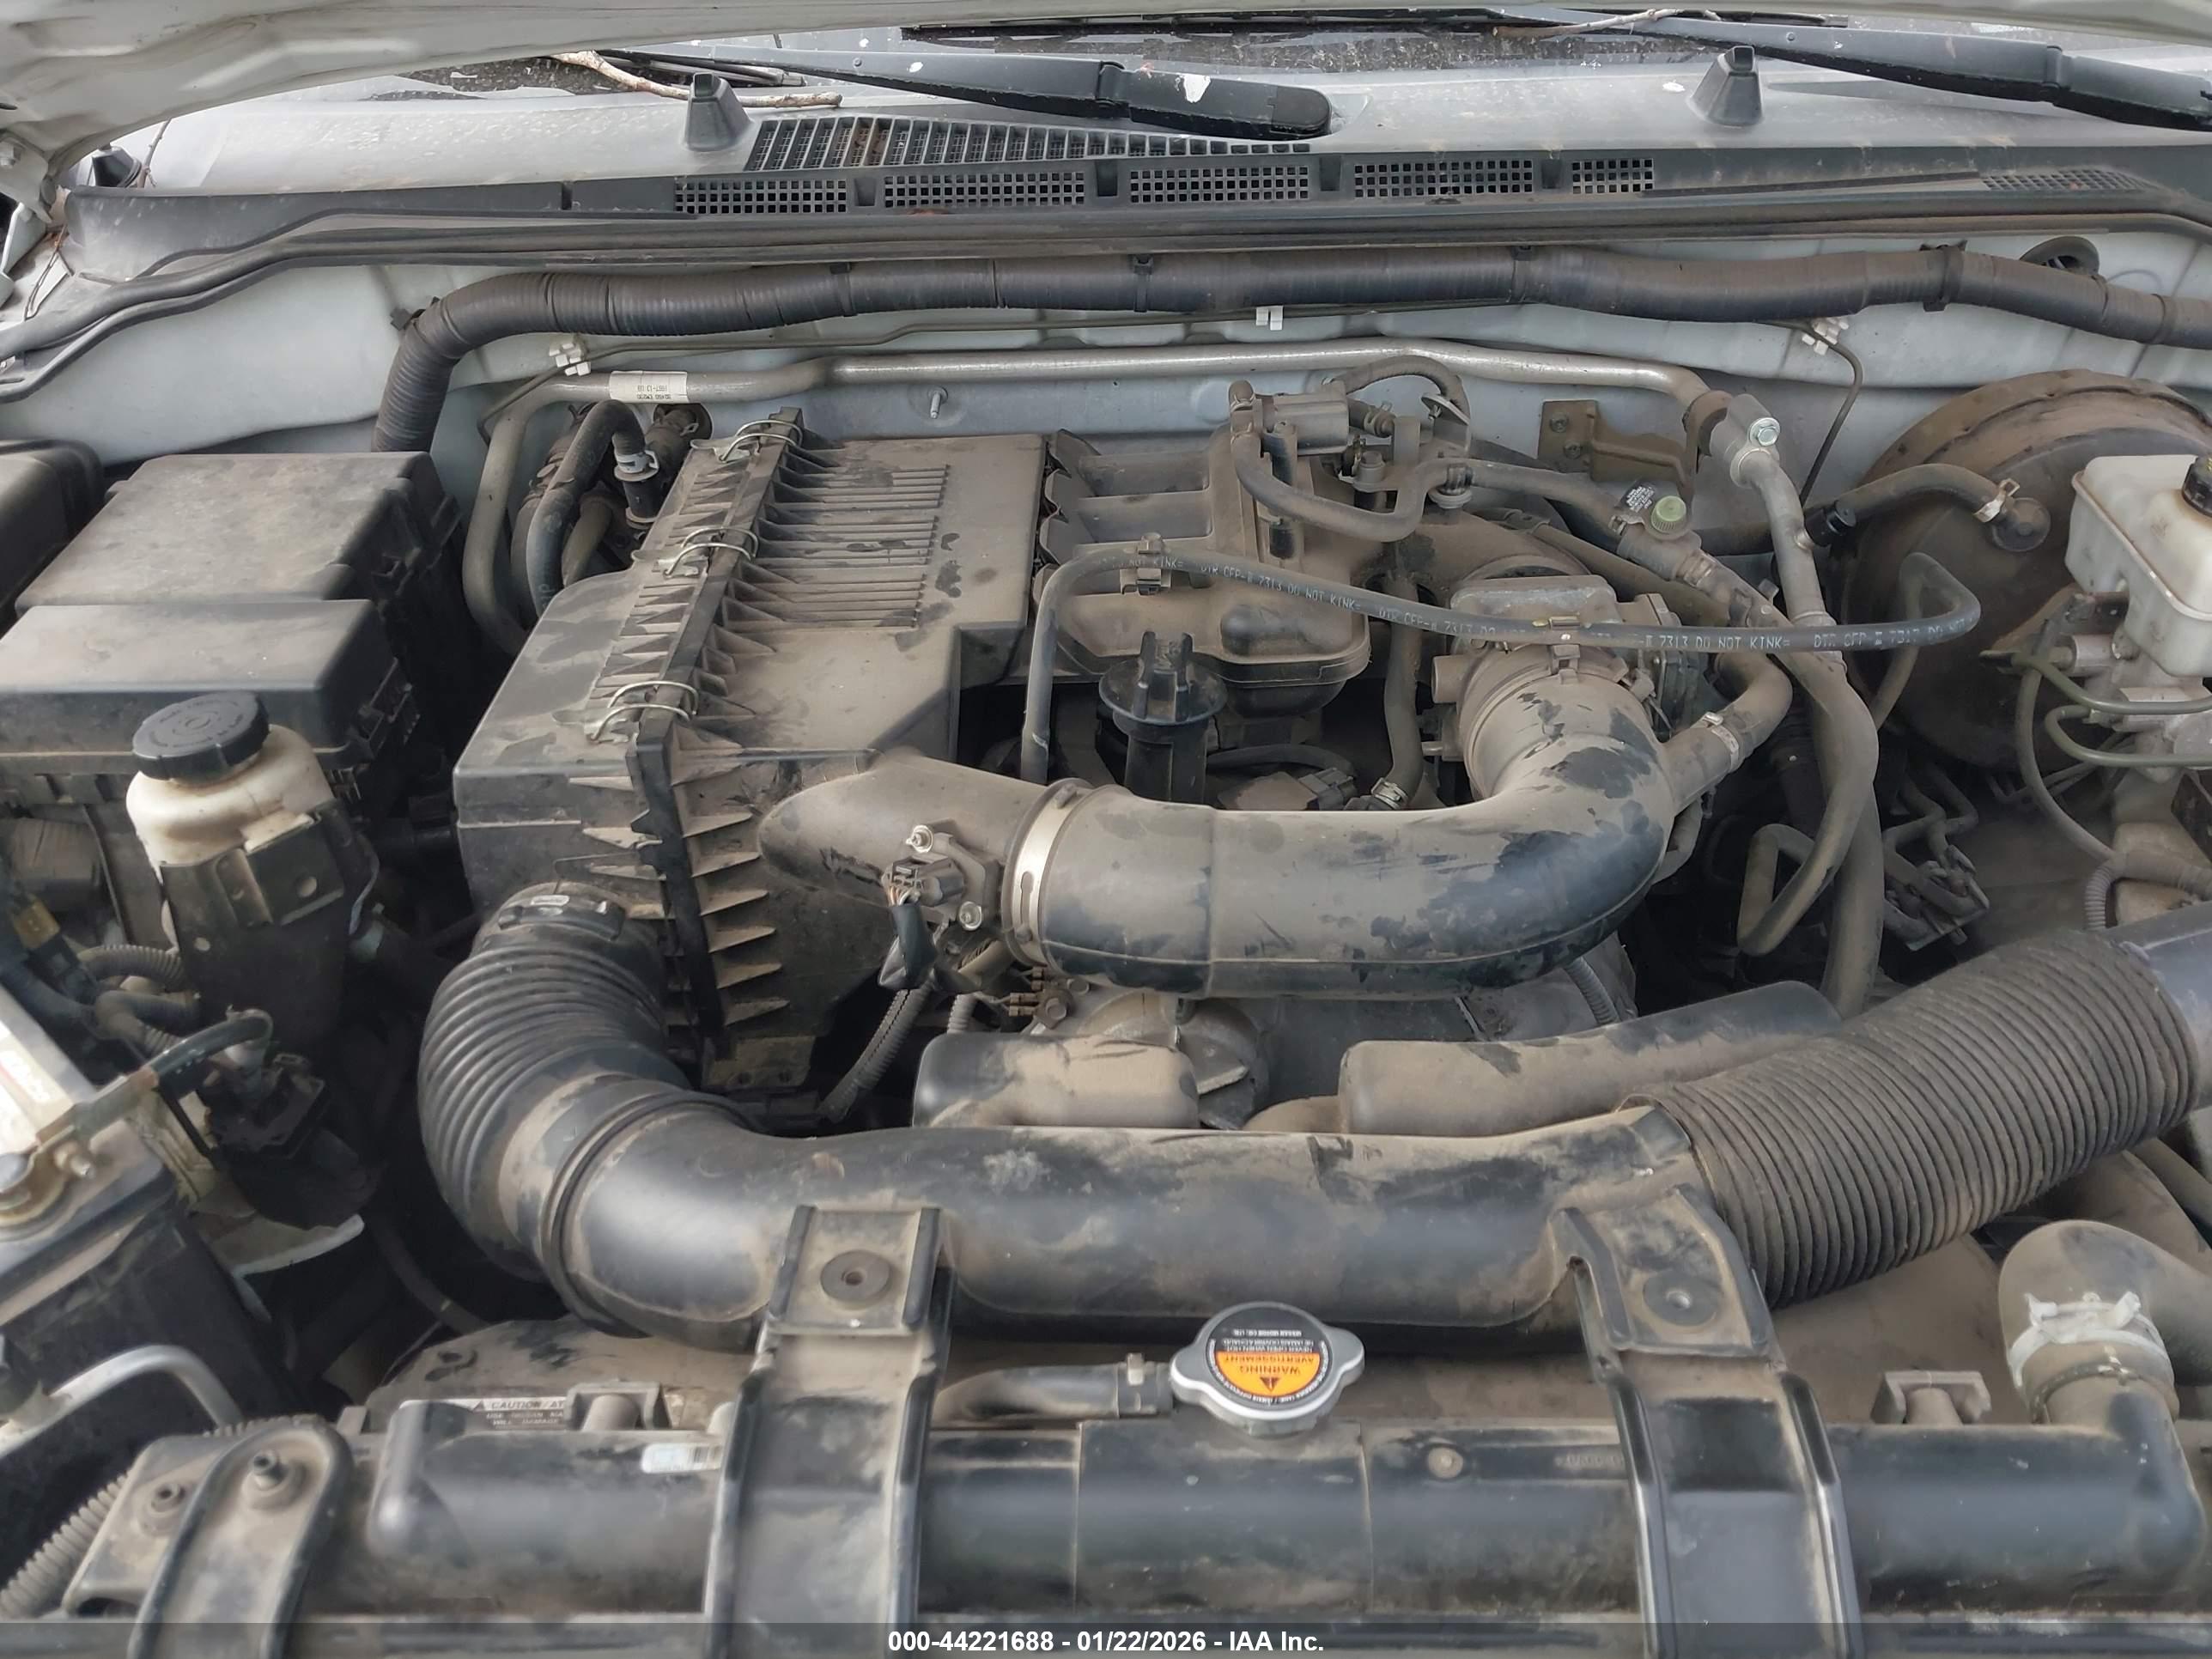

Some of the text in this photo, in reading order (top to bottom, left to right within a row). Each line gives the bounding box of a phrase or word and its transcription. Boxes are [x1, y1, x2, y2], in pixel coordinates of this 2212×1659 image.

[1305, 586, 1325, 603] NOT
[1329, 593, 1362, 611] KINK=
[1695, 635, 1711, 648] DO
[1717, 635, 1742, 649] NOT
[1749, 635, 1790, 649] KINK=
[1224, 1354, 1315, 1364] AVERTISSEMENT
[1239, 1365, 1301, 1375] WARNING
